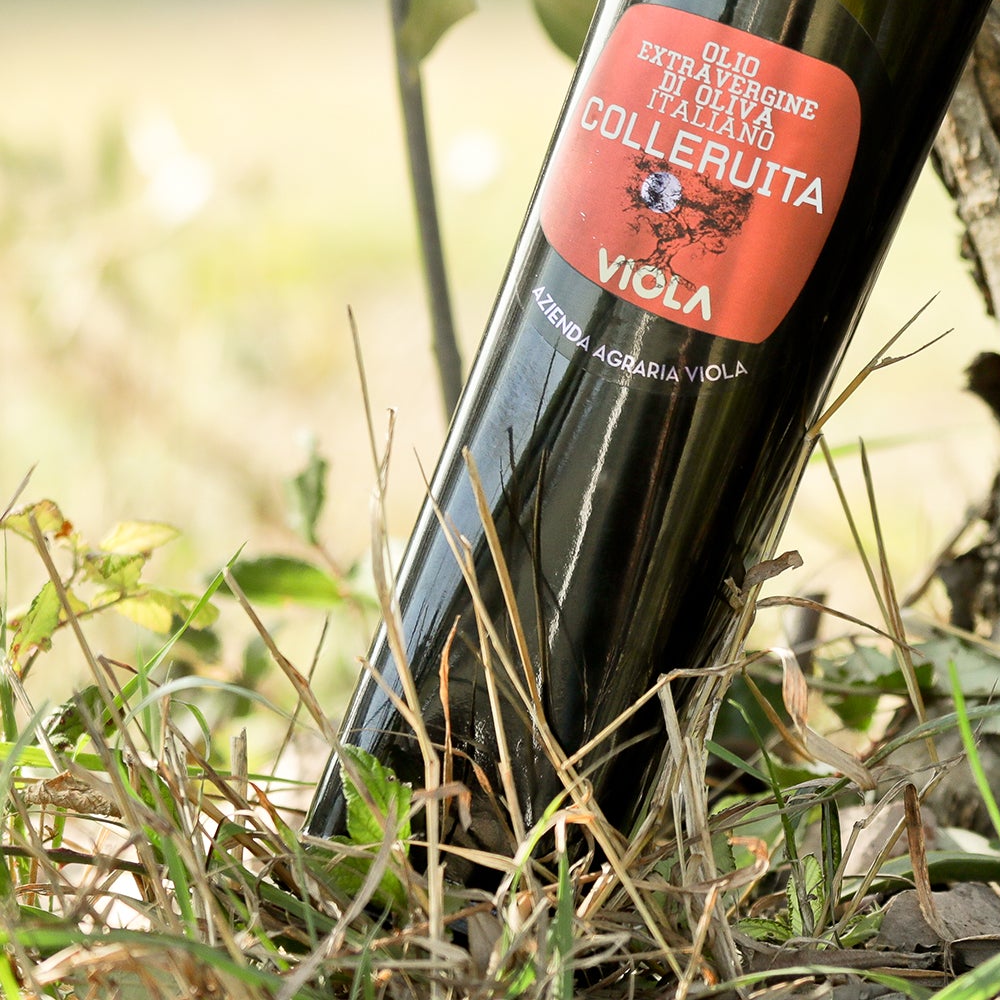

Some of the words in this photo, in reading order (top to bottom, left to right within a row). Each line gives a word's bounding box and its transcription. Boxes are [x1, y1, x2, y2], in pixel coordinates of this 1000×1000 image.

[637, 40, 819, 121] EXTRAVERGINE
[702, 41, 760, 78] OLIO
[646, 89, 775, 152] ITALIANO
[658, 70, 686, 96] DI
[695, 83, 774, 130] OLIVA
[580, 96, 824, 214] COLLERUITA
[598, 247, 711, 321] VIOLA
[532, 286, 590, 352] AZIENDA
[593, 345, 680, 382] AGRARIA
[685, 360, 748, 383] VIOLA
